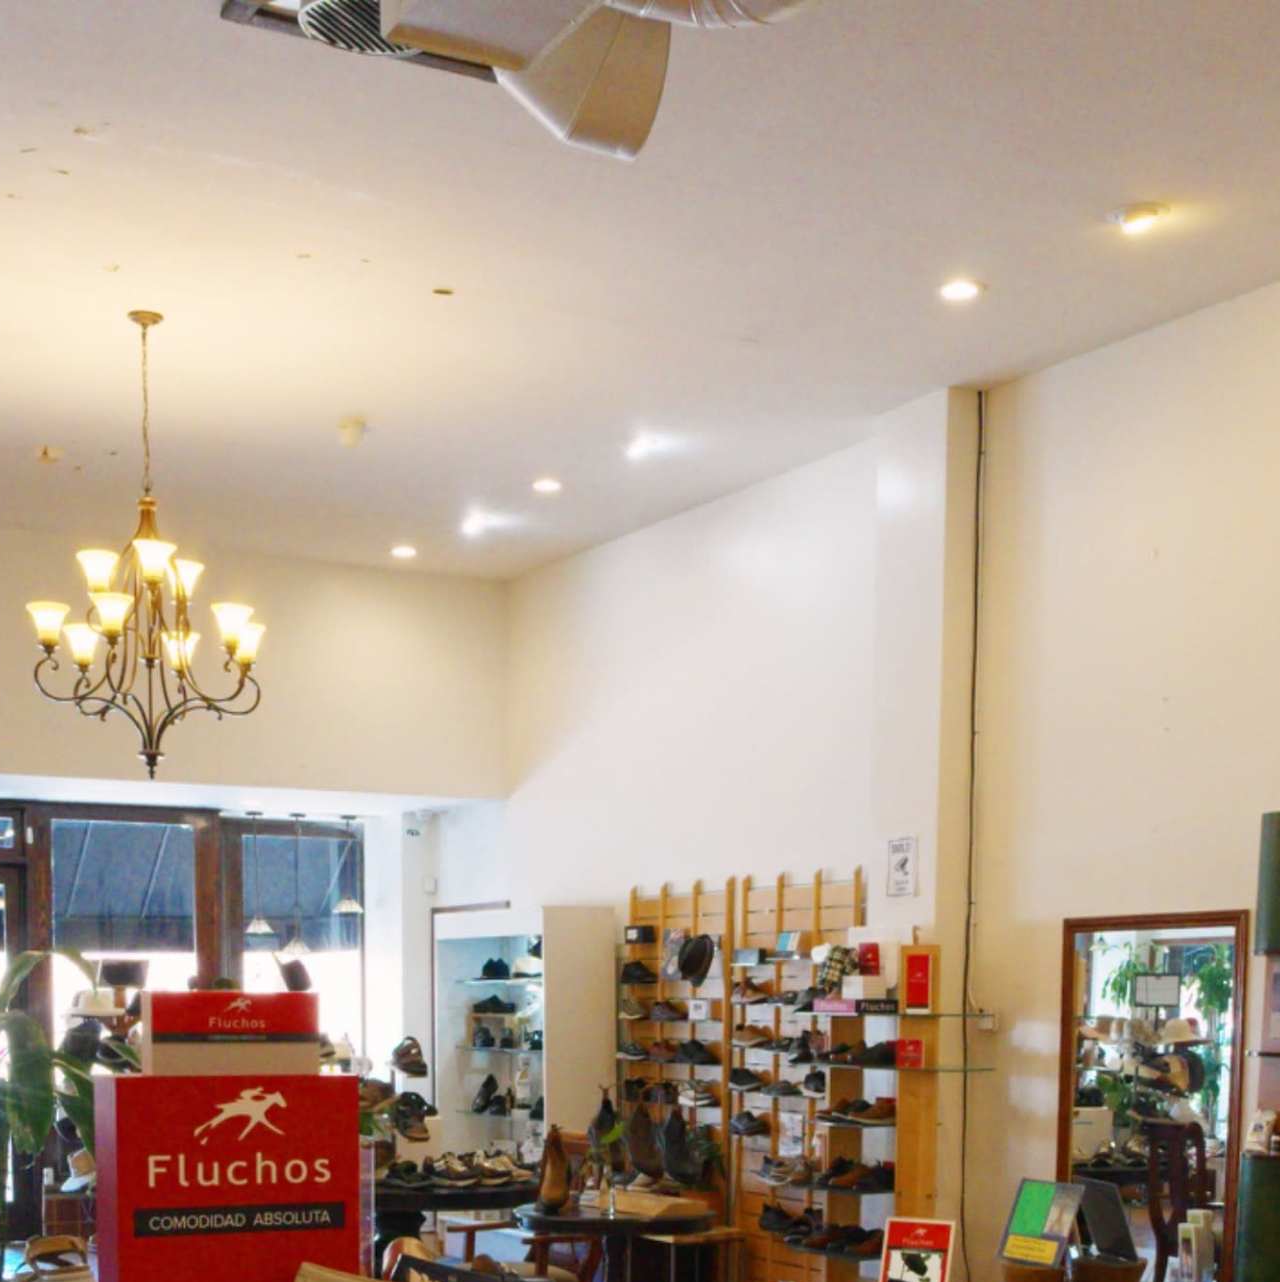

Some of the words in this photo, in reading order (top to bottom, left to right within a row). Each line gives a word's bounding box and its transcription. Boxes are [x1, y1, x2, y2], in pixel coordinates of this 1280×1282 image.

[208, 1017, 267, 1029] Fluchos
[147, 1152, 332, 1188] Fluchos
[148, 1212, 247, 1231] COMODIDAD
[253, 1211, 332, 1226] ABSOLUTA
